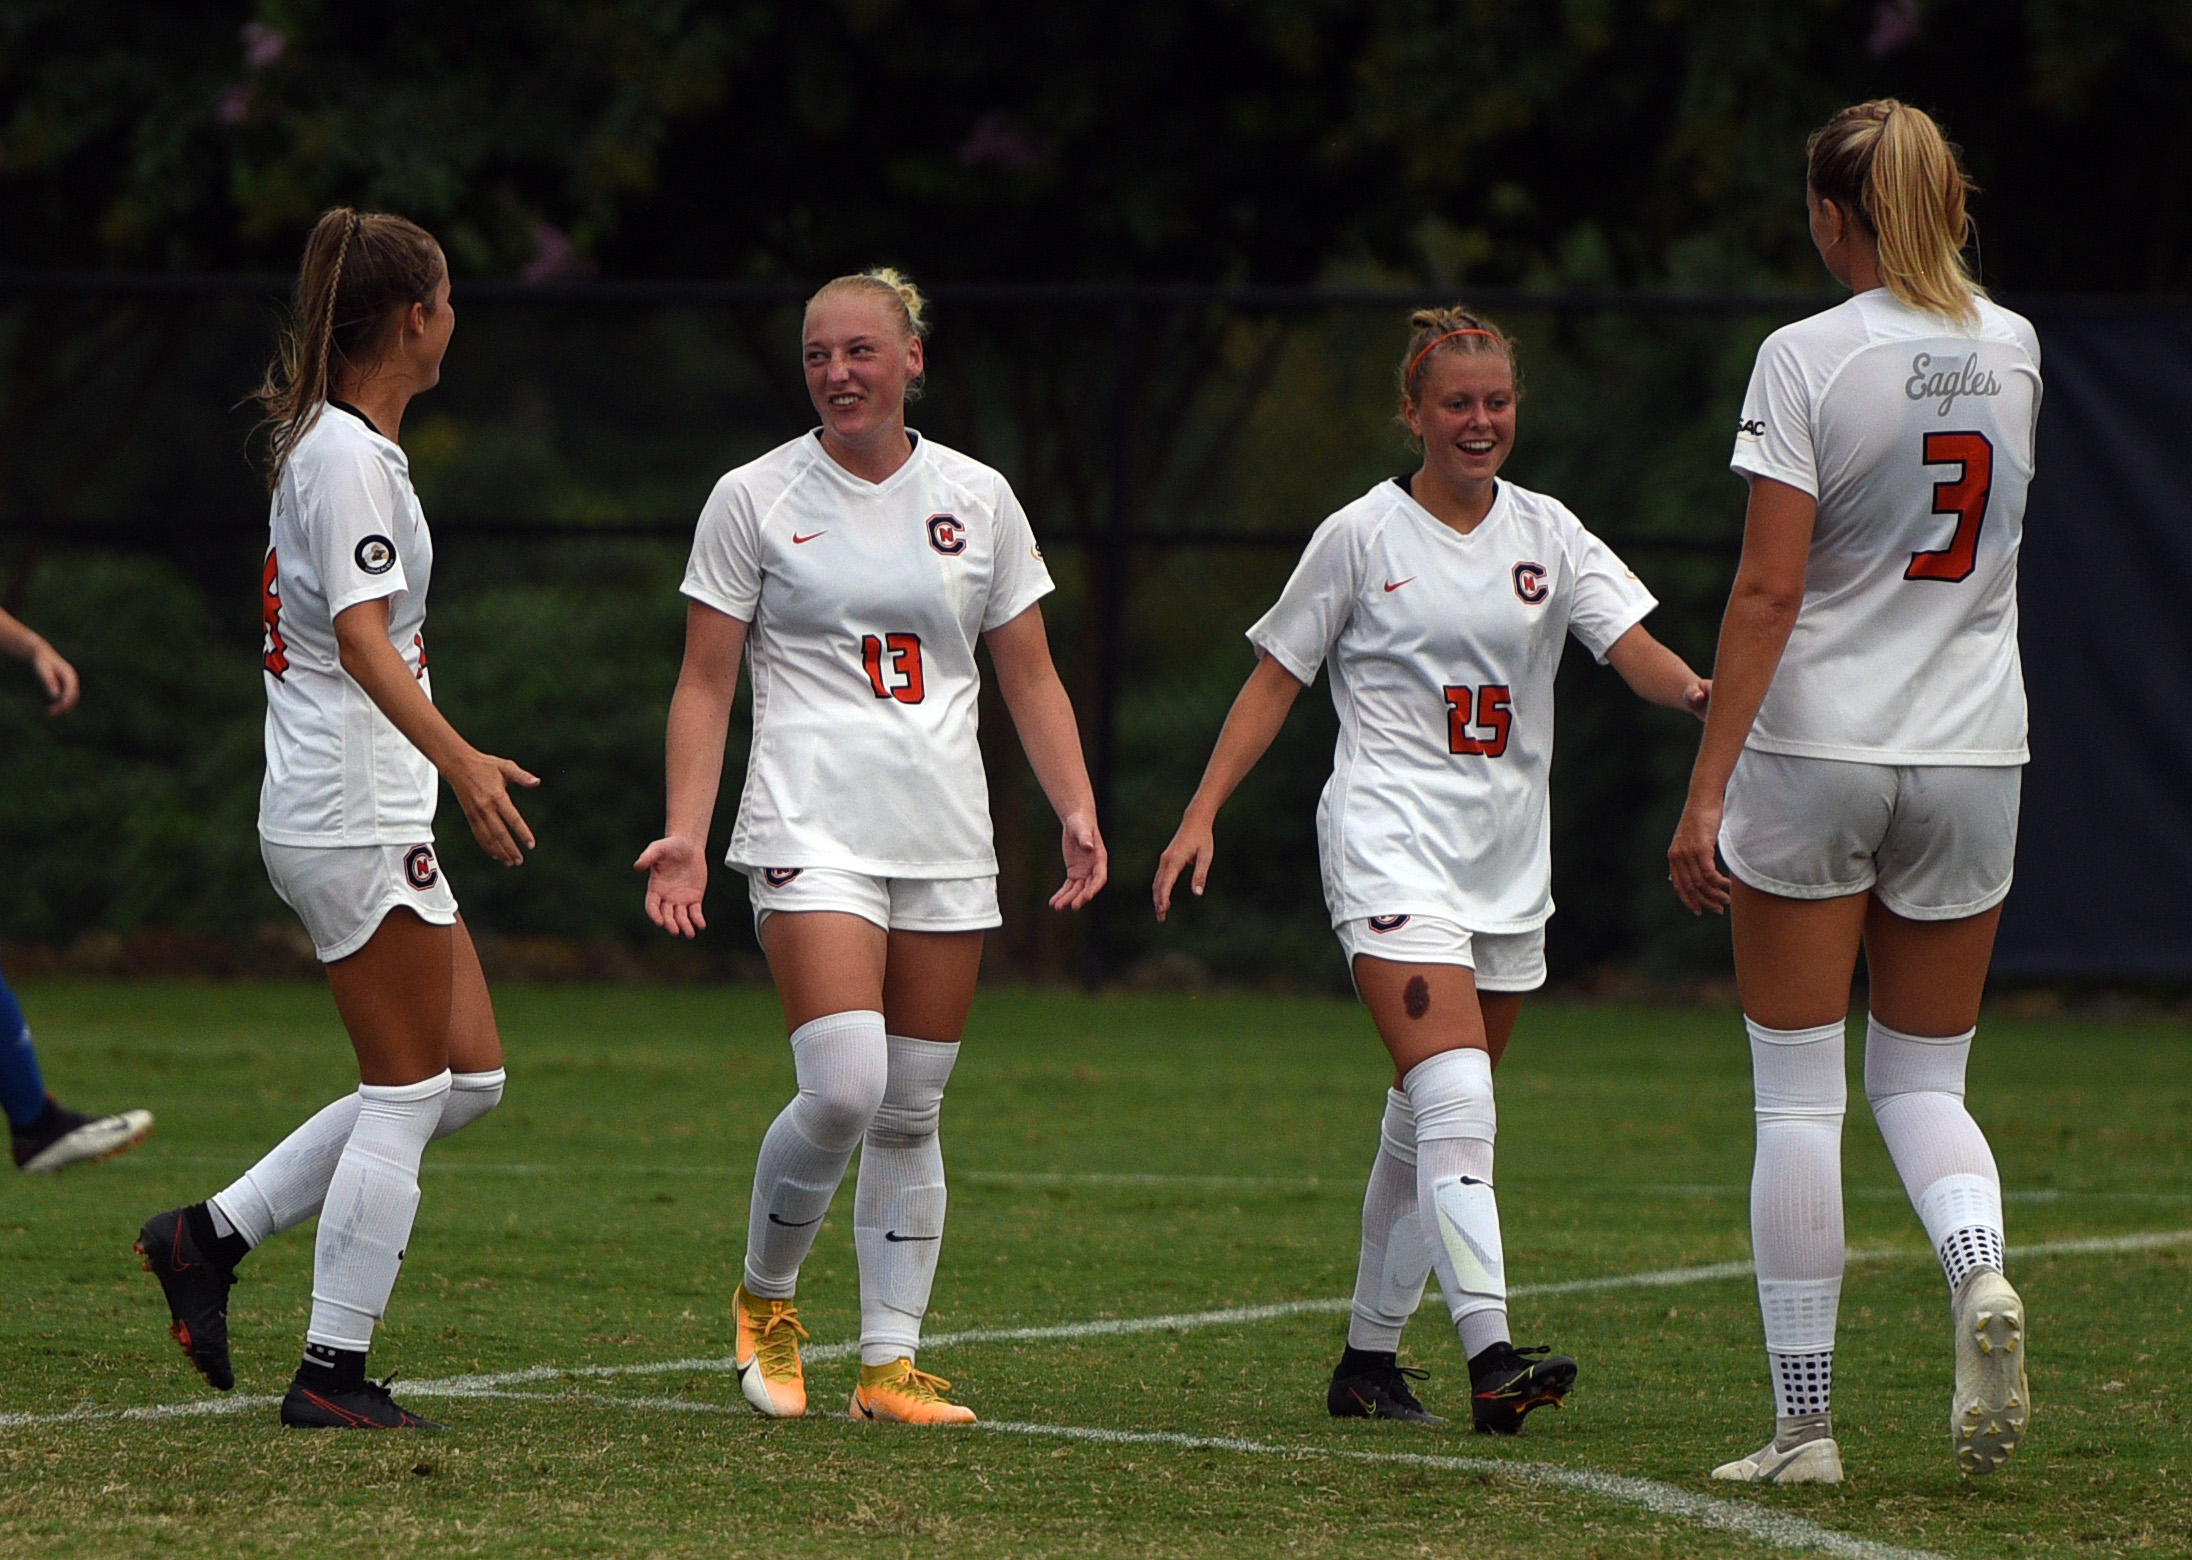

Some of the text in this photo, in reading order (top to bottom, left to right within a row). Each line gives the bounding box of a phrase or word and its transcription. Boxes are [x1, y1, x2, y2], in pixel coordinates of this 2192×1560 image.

[1905, 352, 2001, 417] Eagles
[1903, 431, 1994, 583] 3
[861, 632, 925, 704] 13
[1443, 685, 1512, 758] 25
